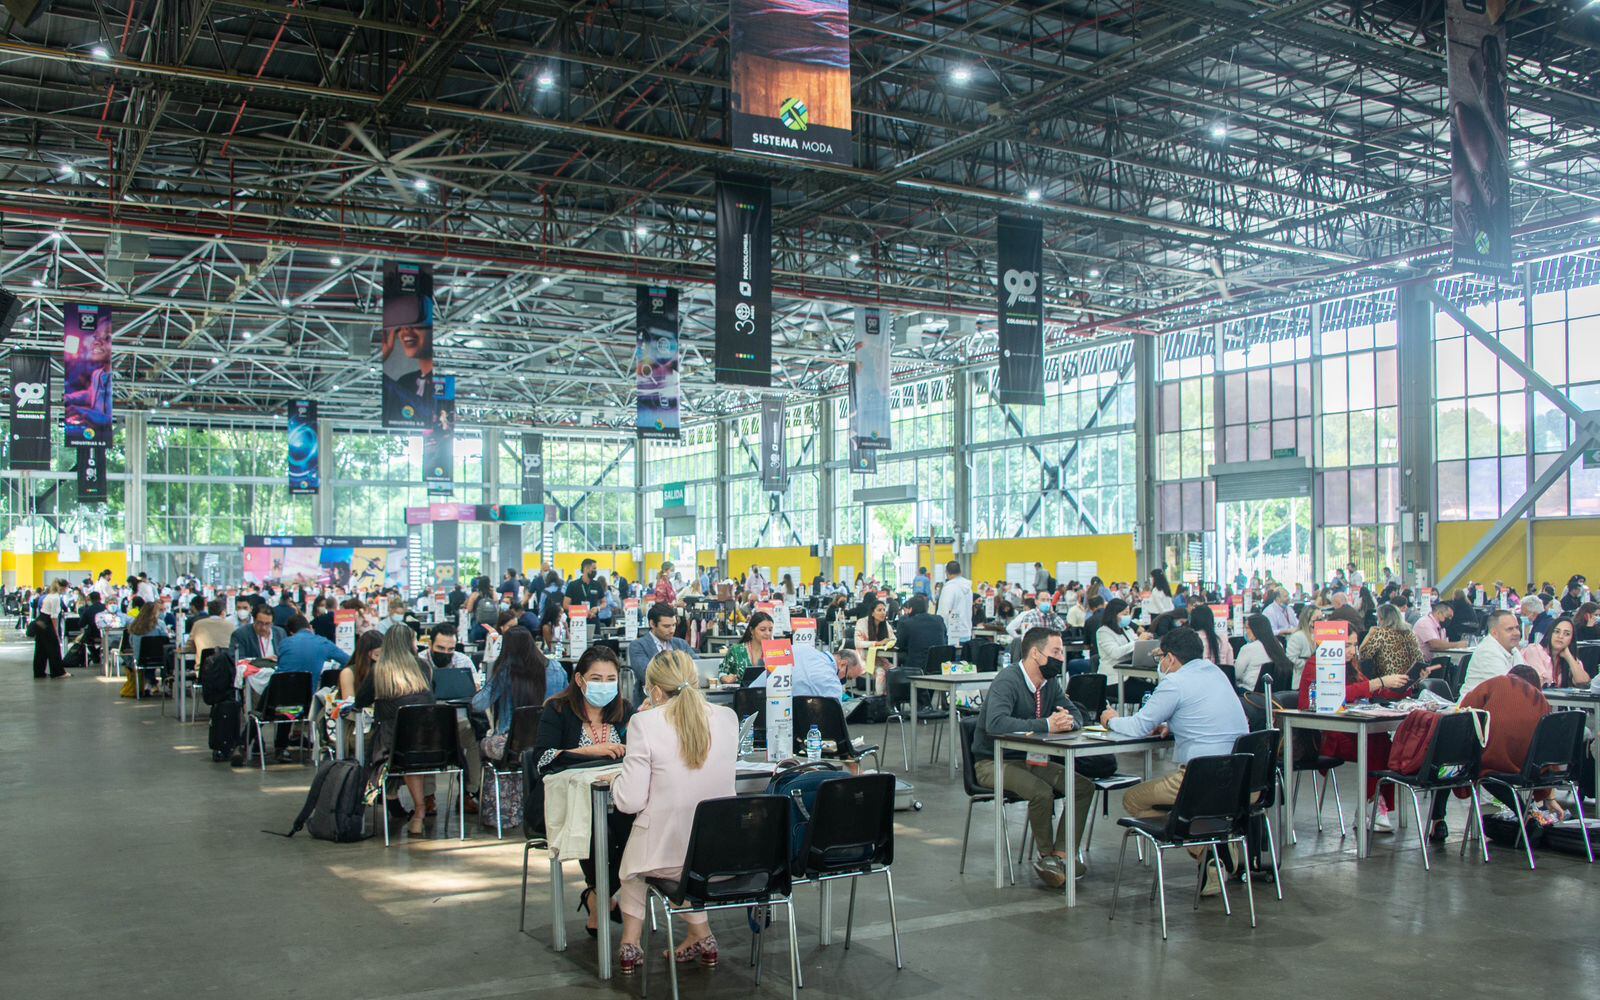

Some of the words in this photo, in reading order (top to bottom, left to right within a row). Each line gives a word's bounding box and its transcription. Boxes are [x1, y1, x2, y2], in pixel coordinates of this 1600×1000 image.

[752, 132, 799, 150] SISTEMA
[801, 139, 834, 154] MODA
[1018, 295, 1036, 303] FORUM
[664, 489, 683, 501] SALIDA
[795, 633, 813, 641] 269
[1320, 647, 1343, 658] 260
